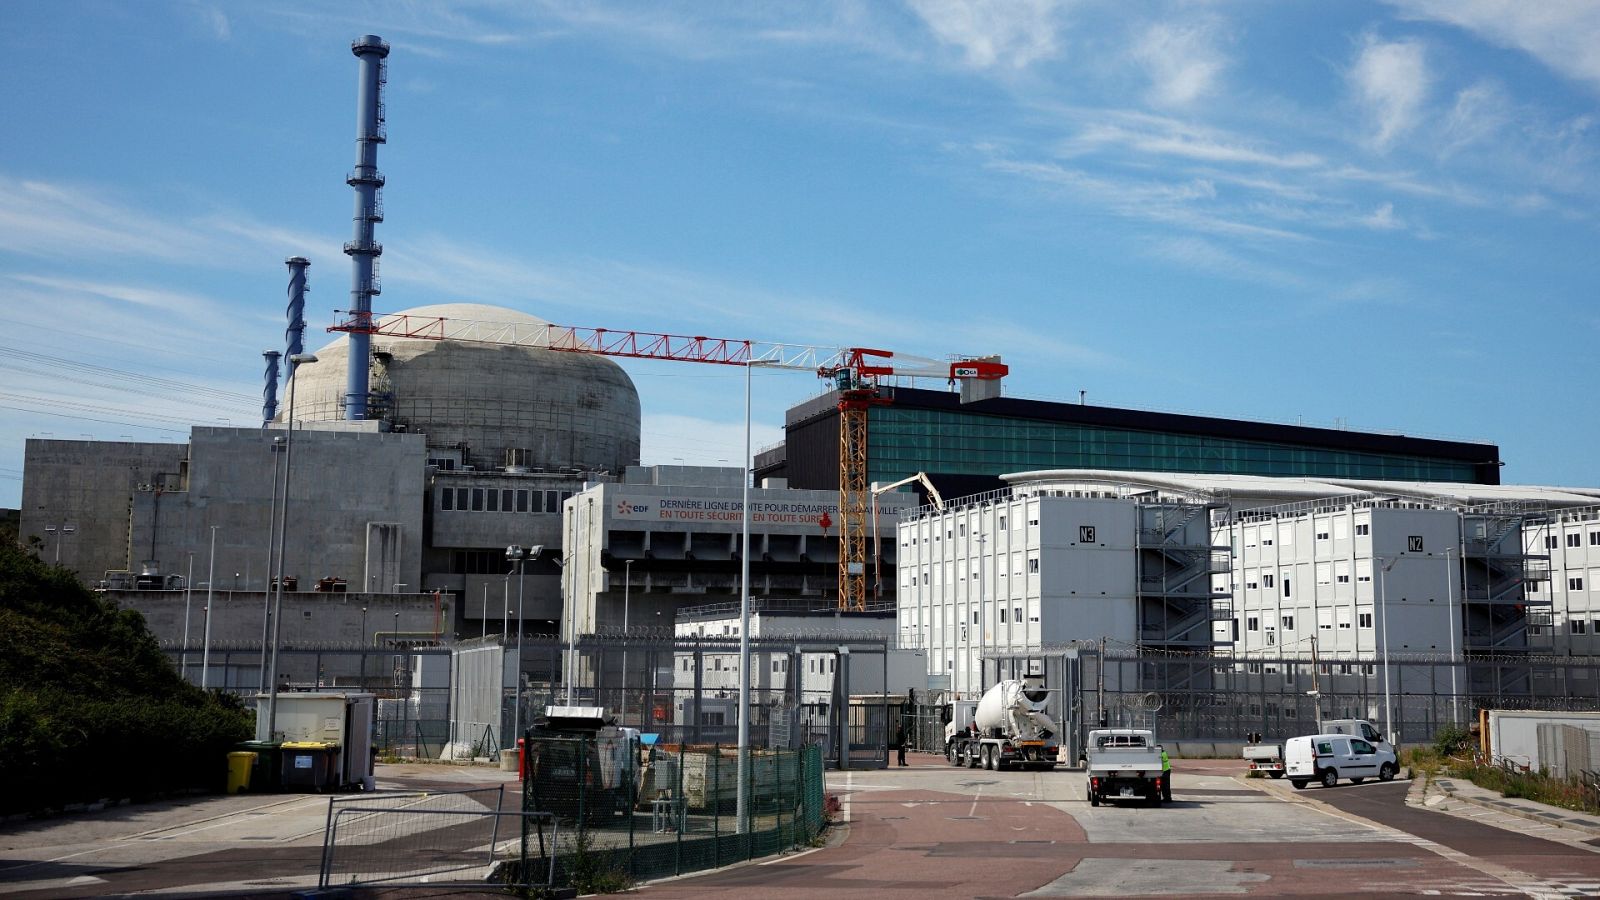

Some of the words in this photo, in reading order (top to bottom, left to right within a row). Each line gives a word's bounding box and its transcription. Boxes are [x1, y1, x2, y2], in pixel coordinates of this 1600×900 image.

[660, 499, 702, 510] DERNIÈRE
[704, 501, 729, 511] LIGNE
[765, 503, 789, 513] POUR
[791, 503, 839, 514] DÉMARRER
[660, 510, 672, 519] EN
[674, 510, 704, 520] TOUTE
[707, 511, 746, 521] SÉCURIT
[753, 513, 765, 522] EN
[767, 513, 797, 523] TOUTE
[1080, 527, 1095, 542] N3
[1409, 536, 1422, 551] N2
